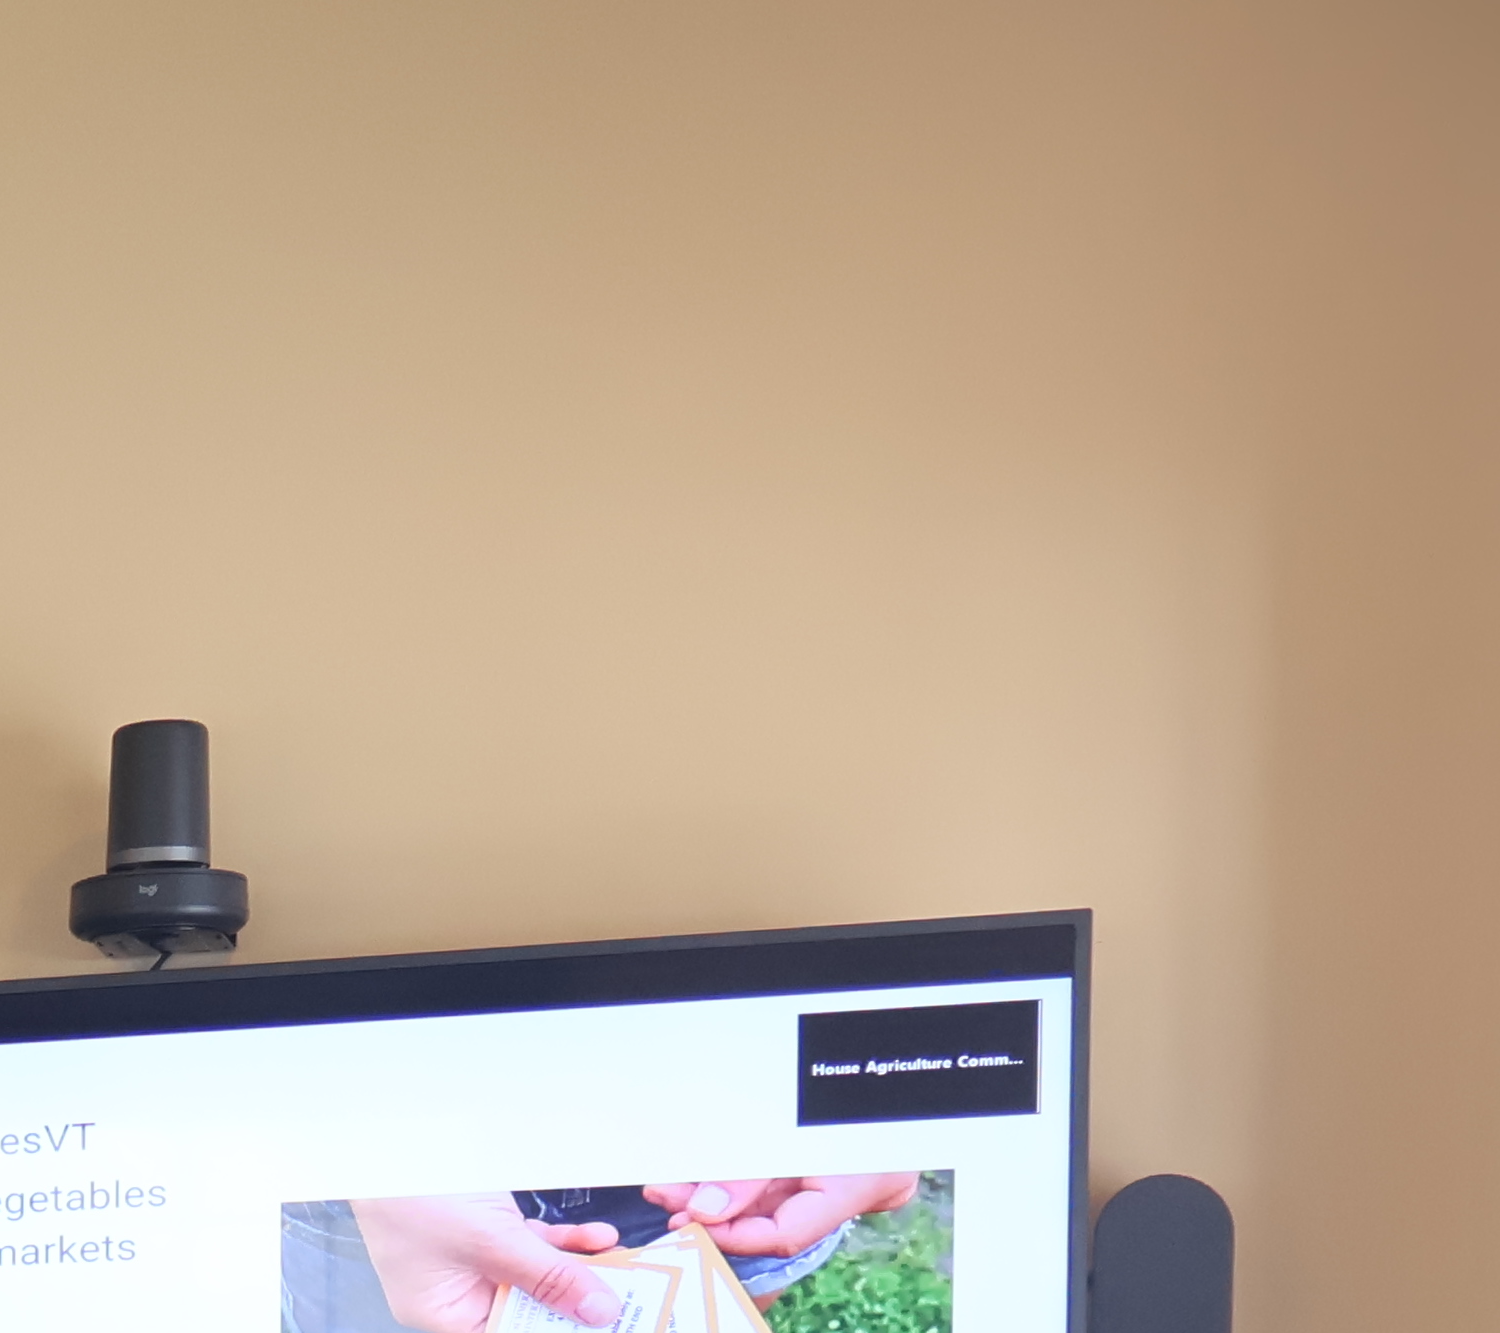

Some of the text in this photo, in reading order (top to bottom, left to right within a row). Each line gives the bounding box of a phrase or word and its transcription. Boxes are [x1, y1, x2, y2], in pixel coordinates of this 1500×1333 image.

[812, 1055, 1023, 1076] House Agriculture Comm...
